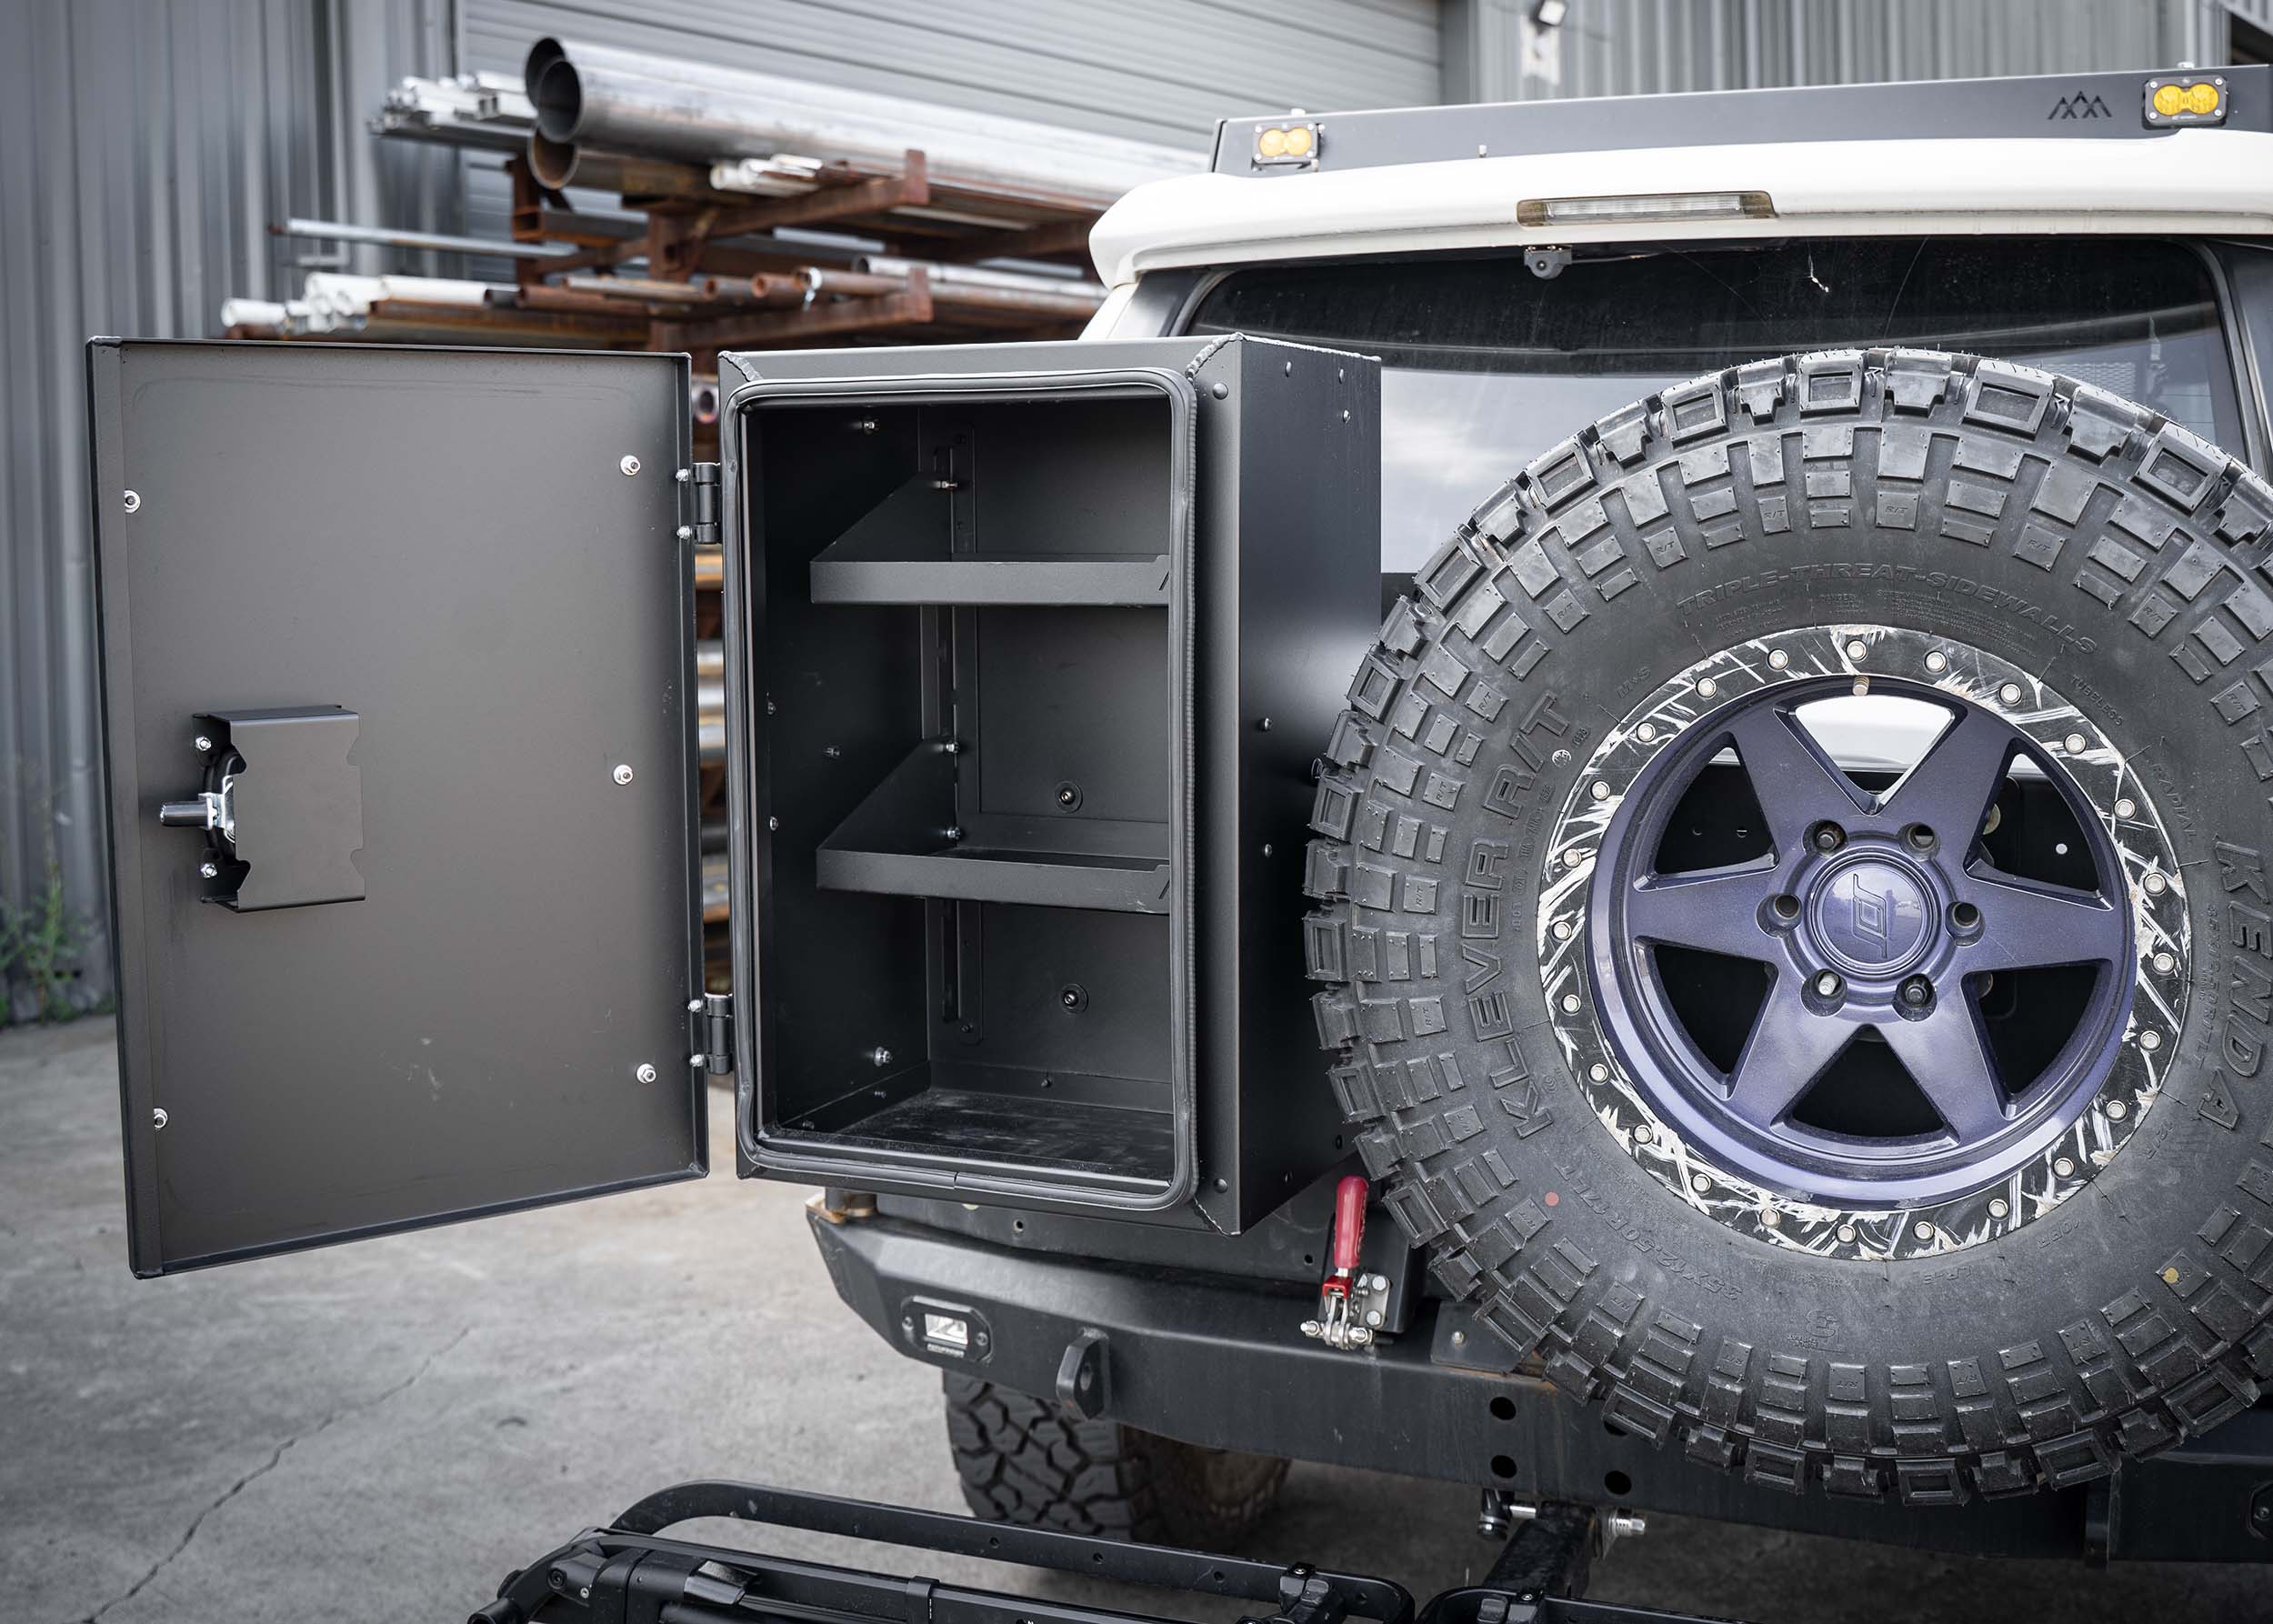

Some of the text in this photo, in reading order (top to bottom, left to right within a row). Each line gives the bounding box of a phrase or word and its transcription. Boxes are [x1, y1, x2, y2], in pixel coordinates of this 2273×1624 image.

[1763, 508, 1786, 519] R/T
[1884, 505, 1908, 515] R/T
[1656, 539, 1676, 555] R/T
[2027, 537, 2052, 552] R/T
[1557, 601, 1574, 619] R/T
[2141, 605, 2165, 624] R/T
[1477, 691, 1491, 711] R/T
[2070, 675, 2124, 727] TUBELESS
[2226, 691, 2247, 713] R/T
[1435, 781, 1447, 802] R/T
[2151, 763, 2197, 838] RADIAL
[1416, 886, 1424, 906] R/T
[1462, 692, 1569, 1140] KLEVER R/T
[2198, 840, 2273, 1130] KENDA
[1421, 1006, 1432, 1027] R/T
[1517, 1209, 1537, 1228] R/T
[1553, 1161, 1744, 1301] 35X12.50R17LT
[1610, 1295, 1630, 1311] R/T
[2070, 1335, 2091, 1351] R/T
[1721, 1353, 1745, 1367] R/T
[1835, 1379, 1858, 1388] R/T
[1954, 1373, 1978, 1385] R/T
